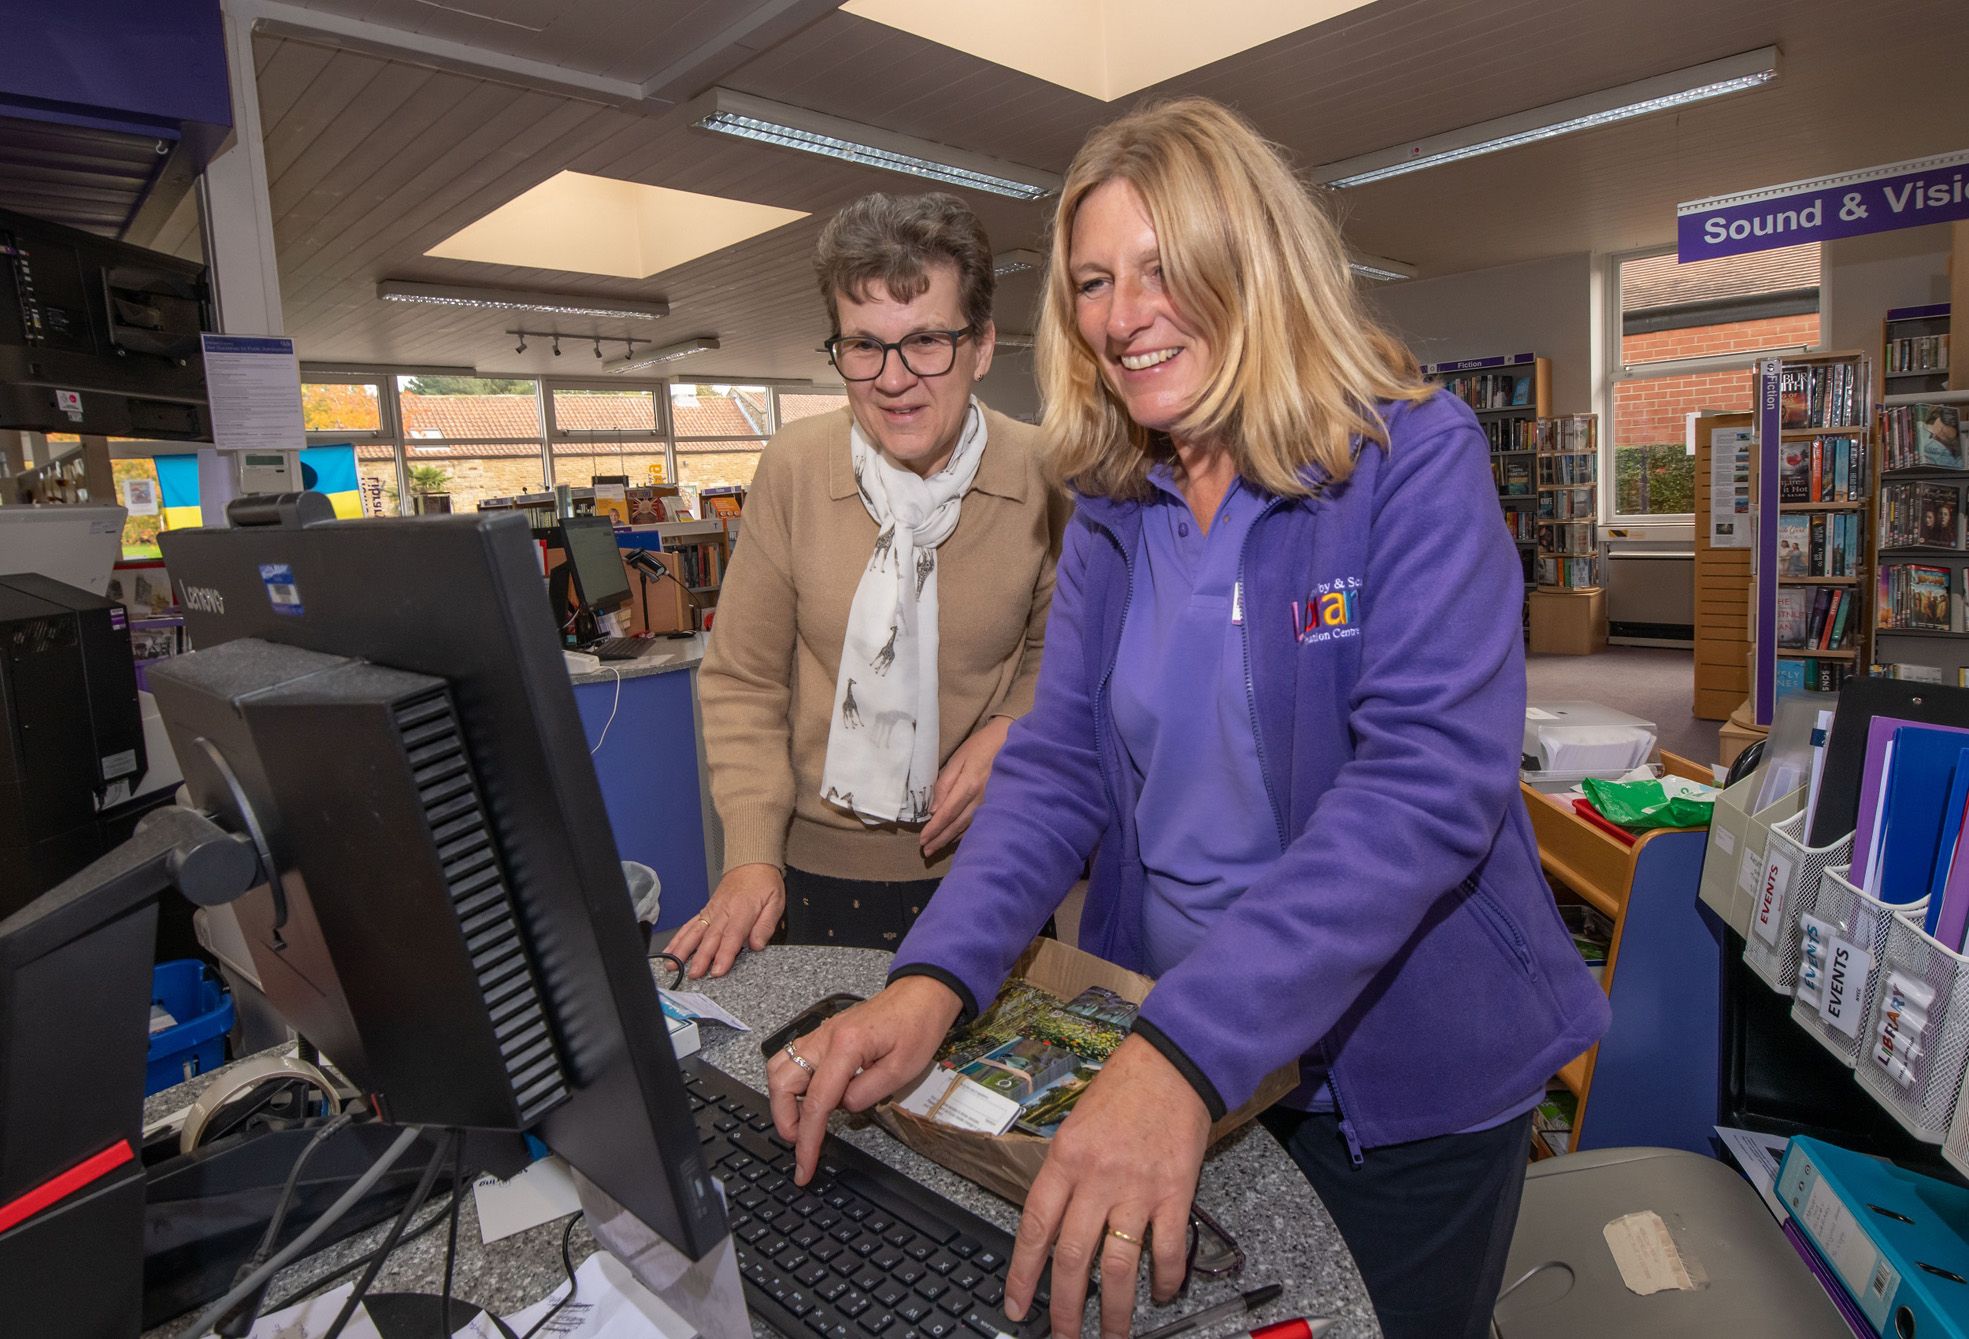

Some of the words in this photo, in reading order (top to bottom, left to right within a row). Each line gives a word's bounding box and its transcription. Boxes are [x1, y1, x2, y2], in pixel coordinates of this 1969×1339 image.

[1703, 199, 1822, 244] Sound
[1838, 192, 1869, 221] &
[1882, 174, 1969, 214] Visi
[1457, 361, 1482, 369] Fiction
[1766, 374, 1778, 410] Fiction
[1334, 578, 1345, 589] &
[1760, 864, 1779, 925] EVENTS
[1805, 924, 1821, 990] EVENTS
[1827, 947, 1849, 1018] EVENTS
[1877, 982, 1905, 1067] LIBRARY
